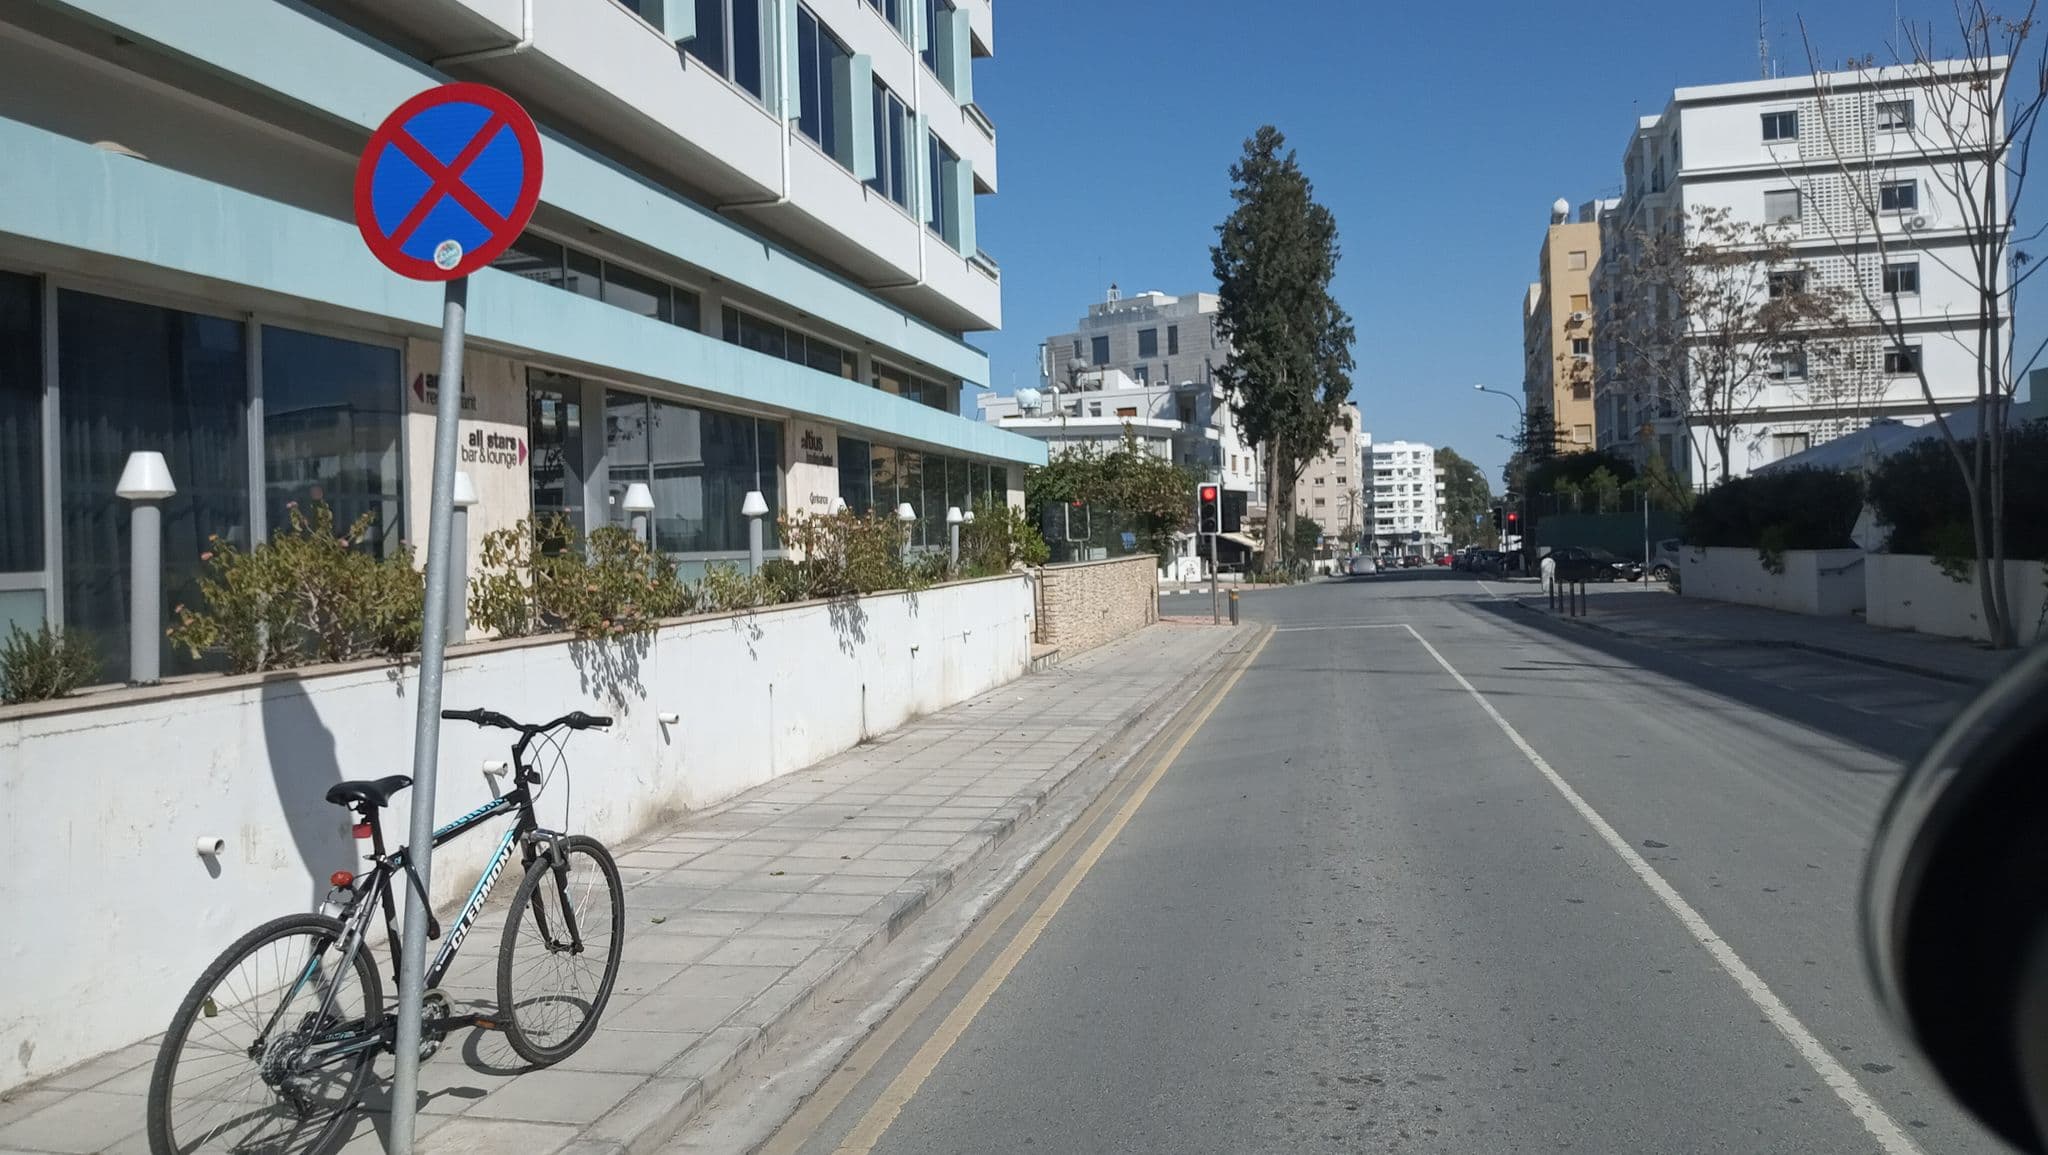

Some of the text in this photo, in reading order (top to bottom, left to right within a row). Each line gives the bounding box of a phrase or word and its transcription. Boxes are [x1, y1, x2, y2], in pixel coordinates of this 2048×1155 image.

[469, 429, 517, 450] all stars
[461, 445, 517, 469] bar & lounge
[450, 837, 516, 951] CLERMONT
